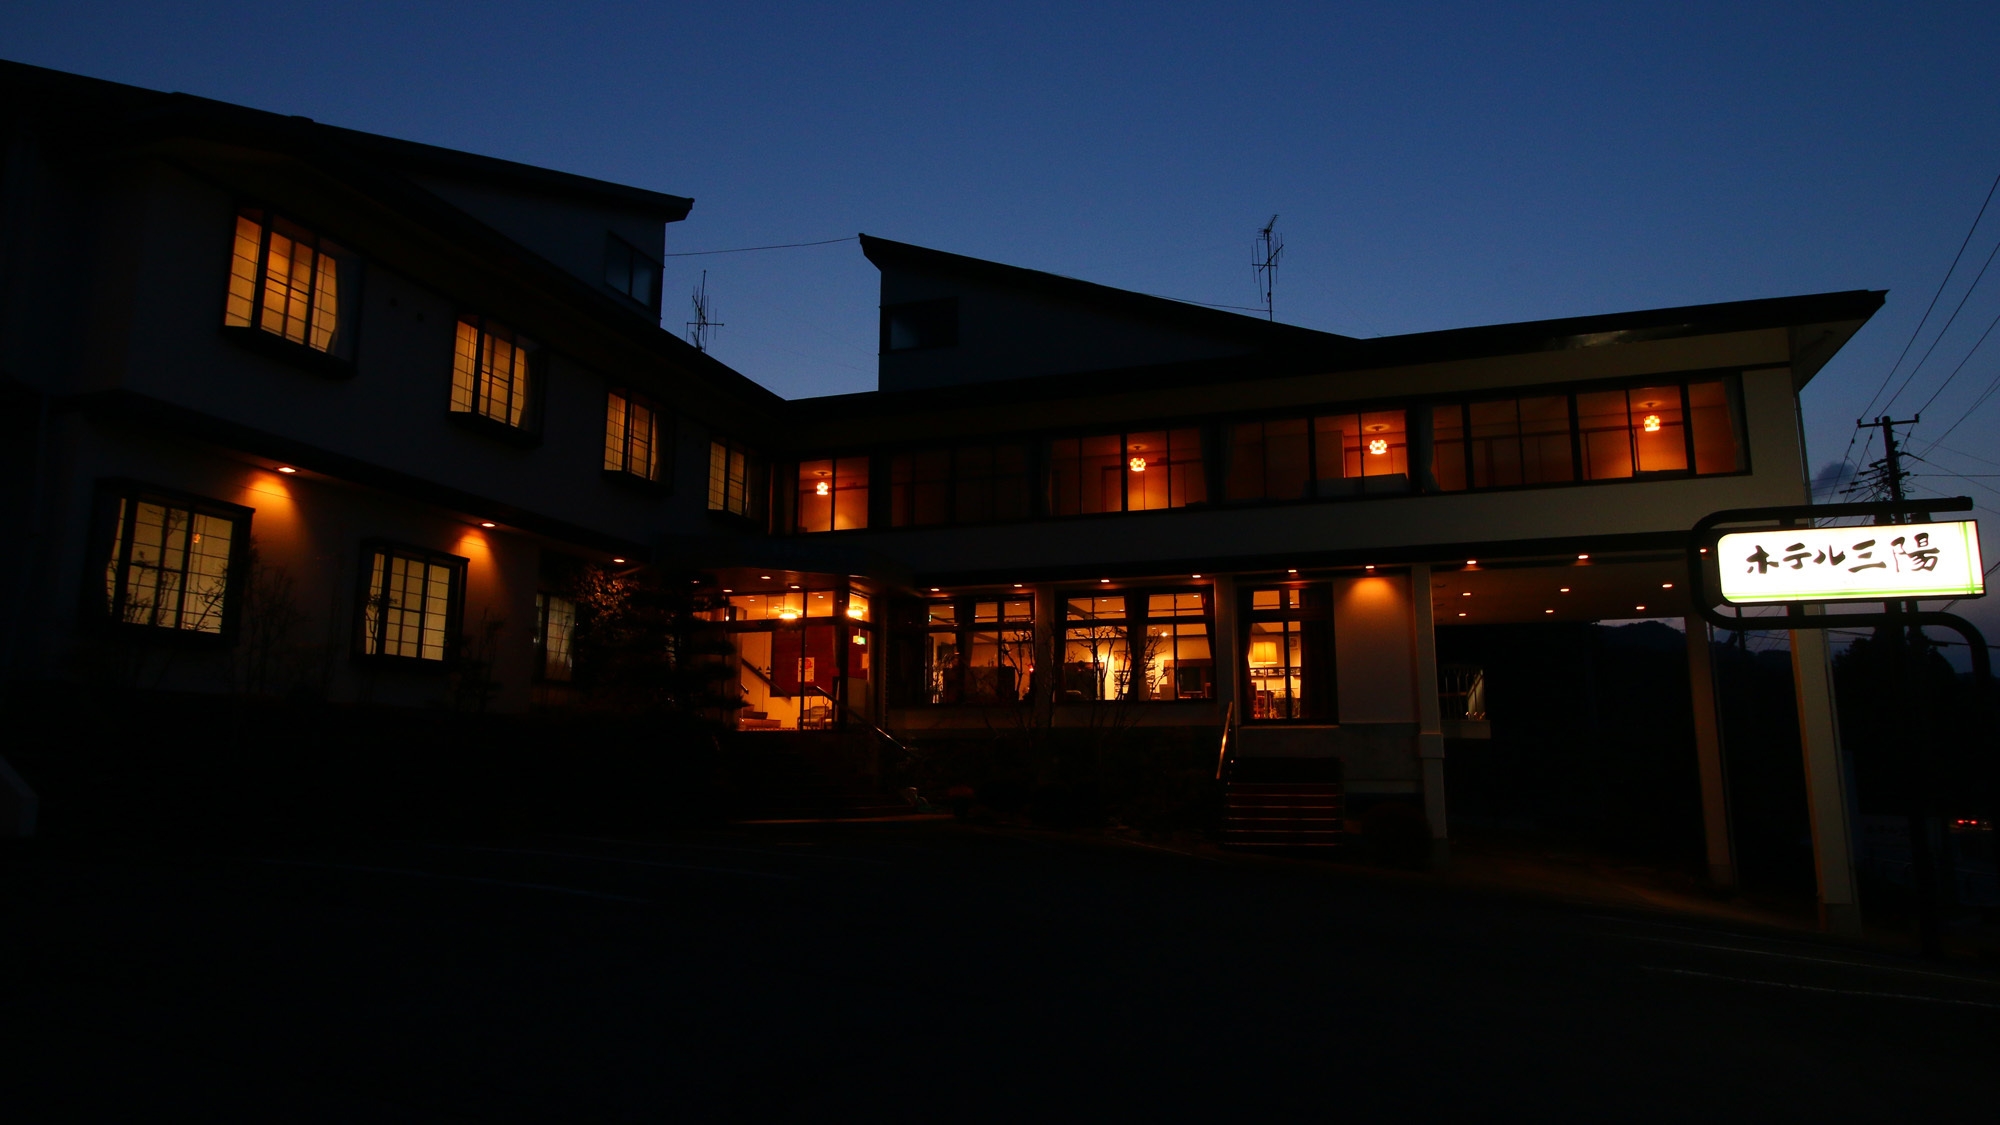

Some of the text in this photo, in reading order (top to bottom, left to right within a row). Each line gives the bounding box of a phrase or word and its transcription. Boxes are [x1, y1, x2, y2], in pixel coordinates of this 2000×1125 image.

[1746, 532, 1940, 575] ホテル三陽
